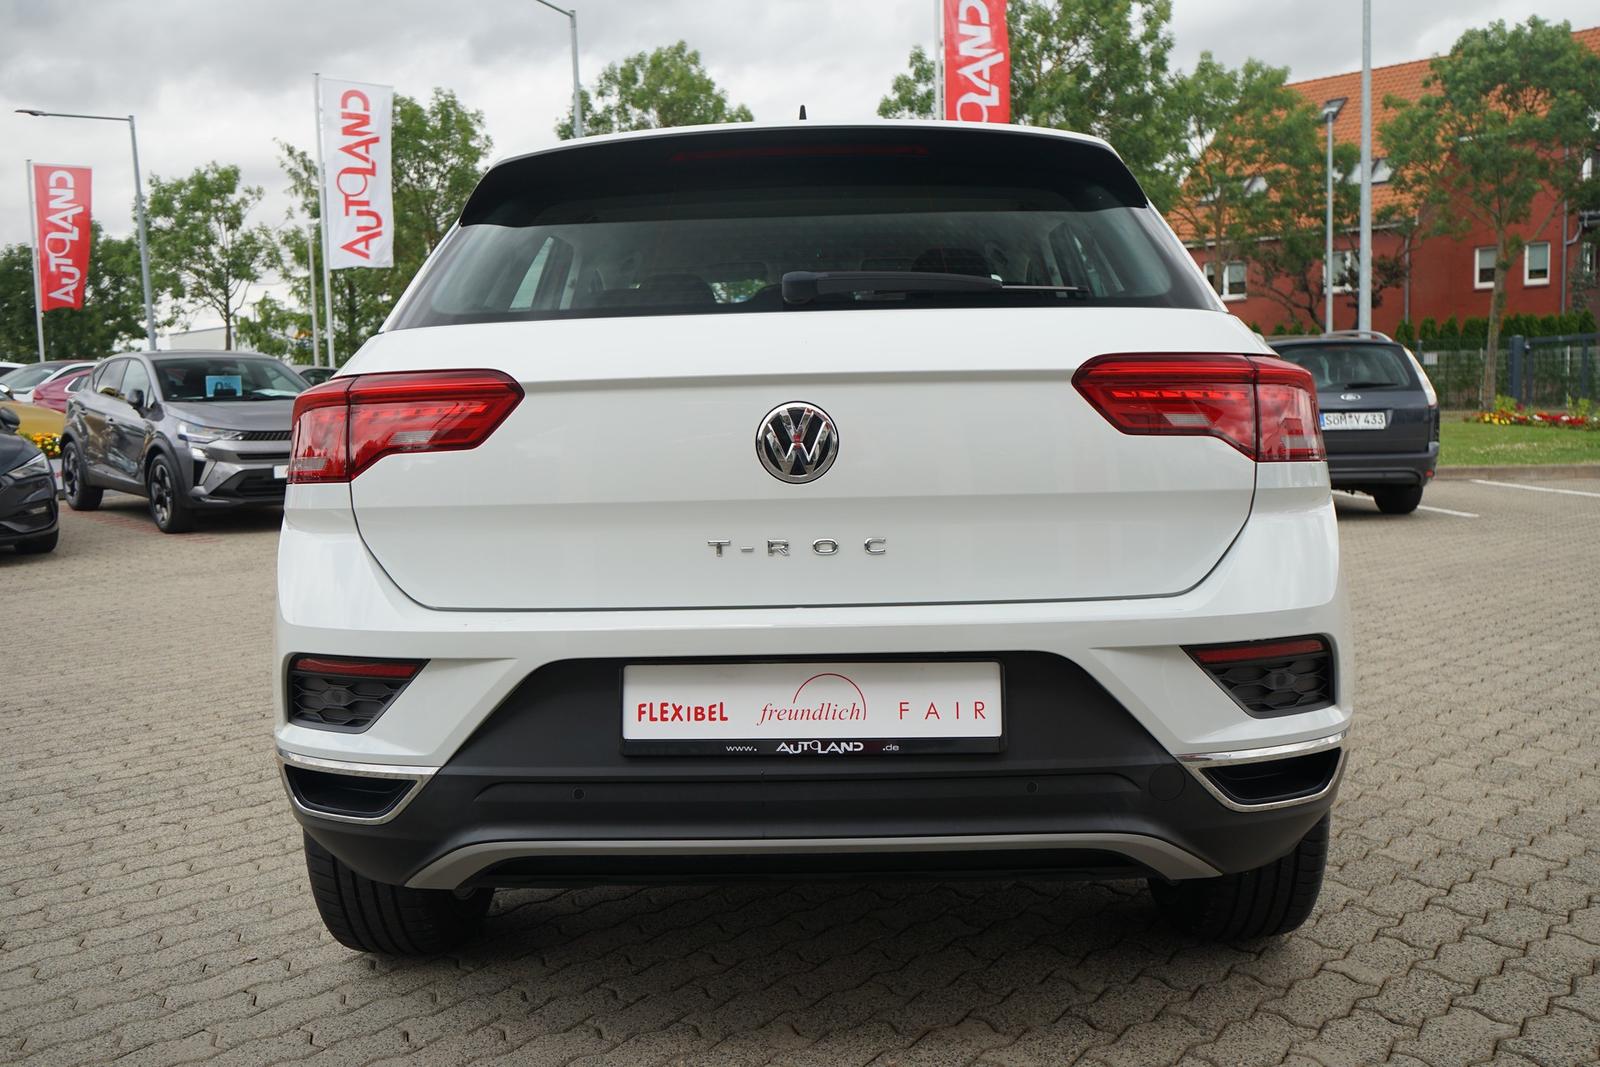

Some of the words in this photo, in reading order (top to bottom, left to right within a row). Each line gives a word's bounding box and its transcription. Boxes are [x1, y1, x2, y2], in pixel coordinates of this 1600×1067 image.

[337, 89, 382, 260] AUTOLAND
[45, 170, 84, 304] AUTOLAND
[1364, 414, 1383, 425] 433
[763, 404, 833, 478] VW
[707, 537, 887, 558] T-ROC
[638, 702, 728, 722] FLEXIBEL
[757, 702, 860, 726] freundlich
[899, 701, 986, 720] FAIR
[776, 740, 864, 754] AUTOLAND
